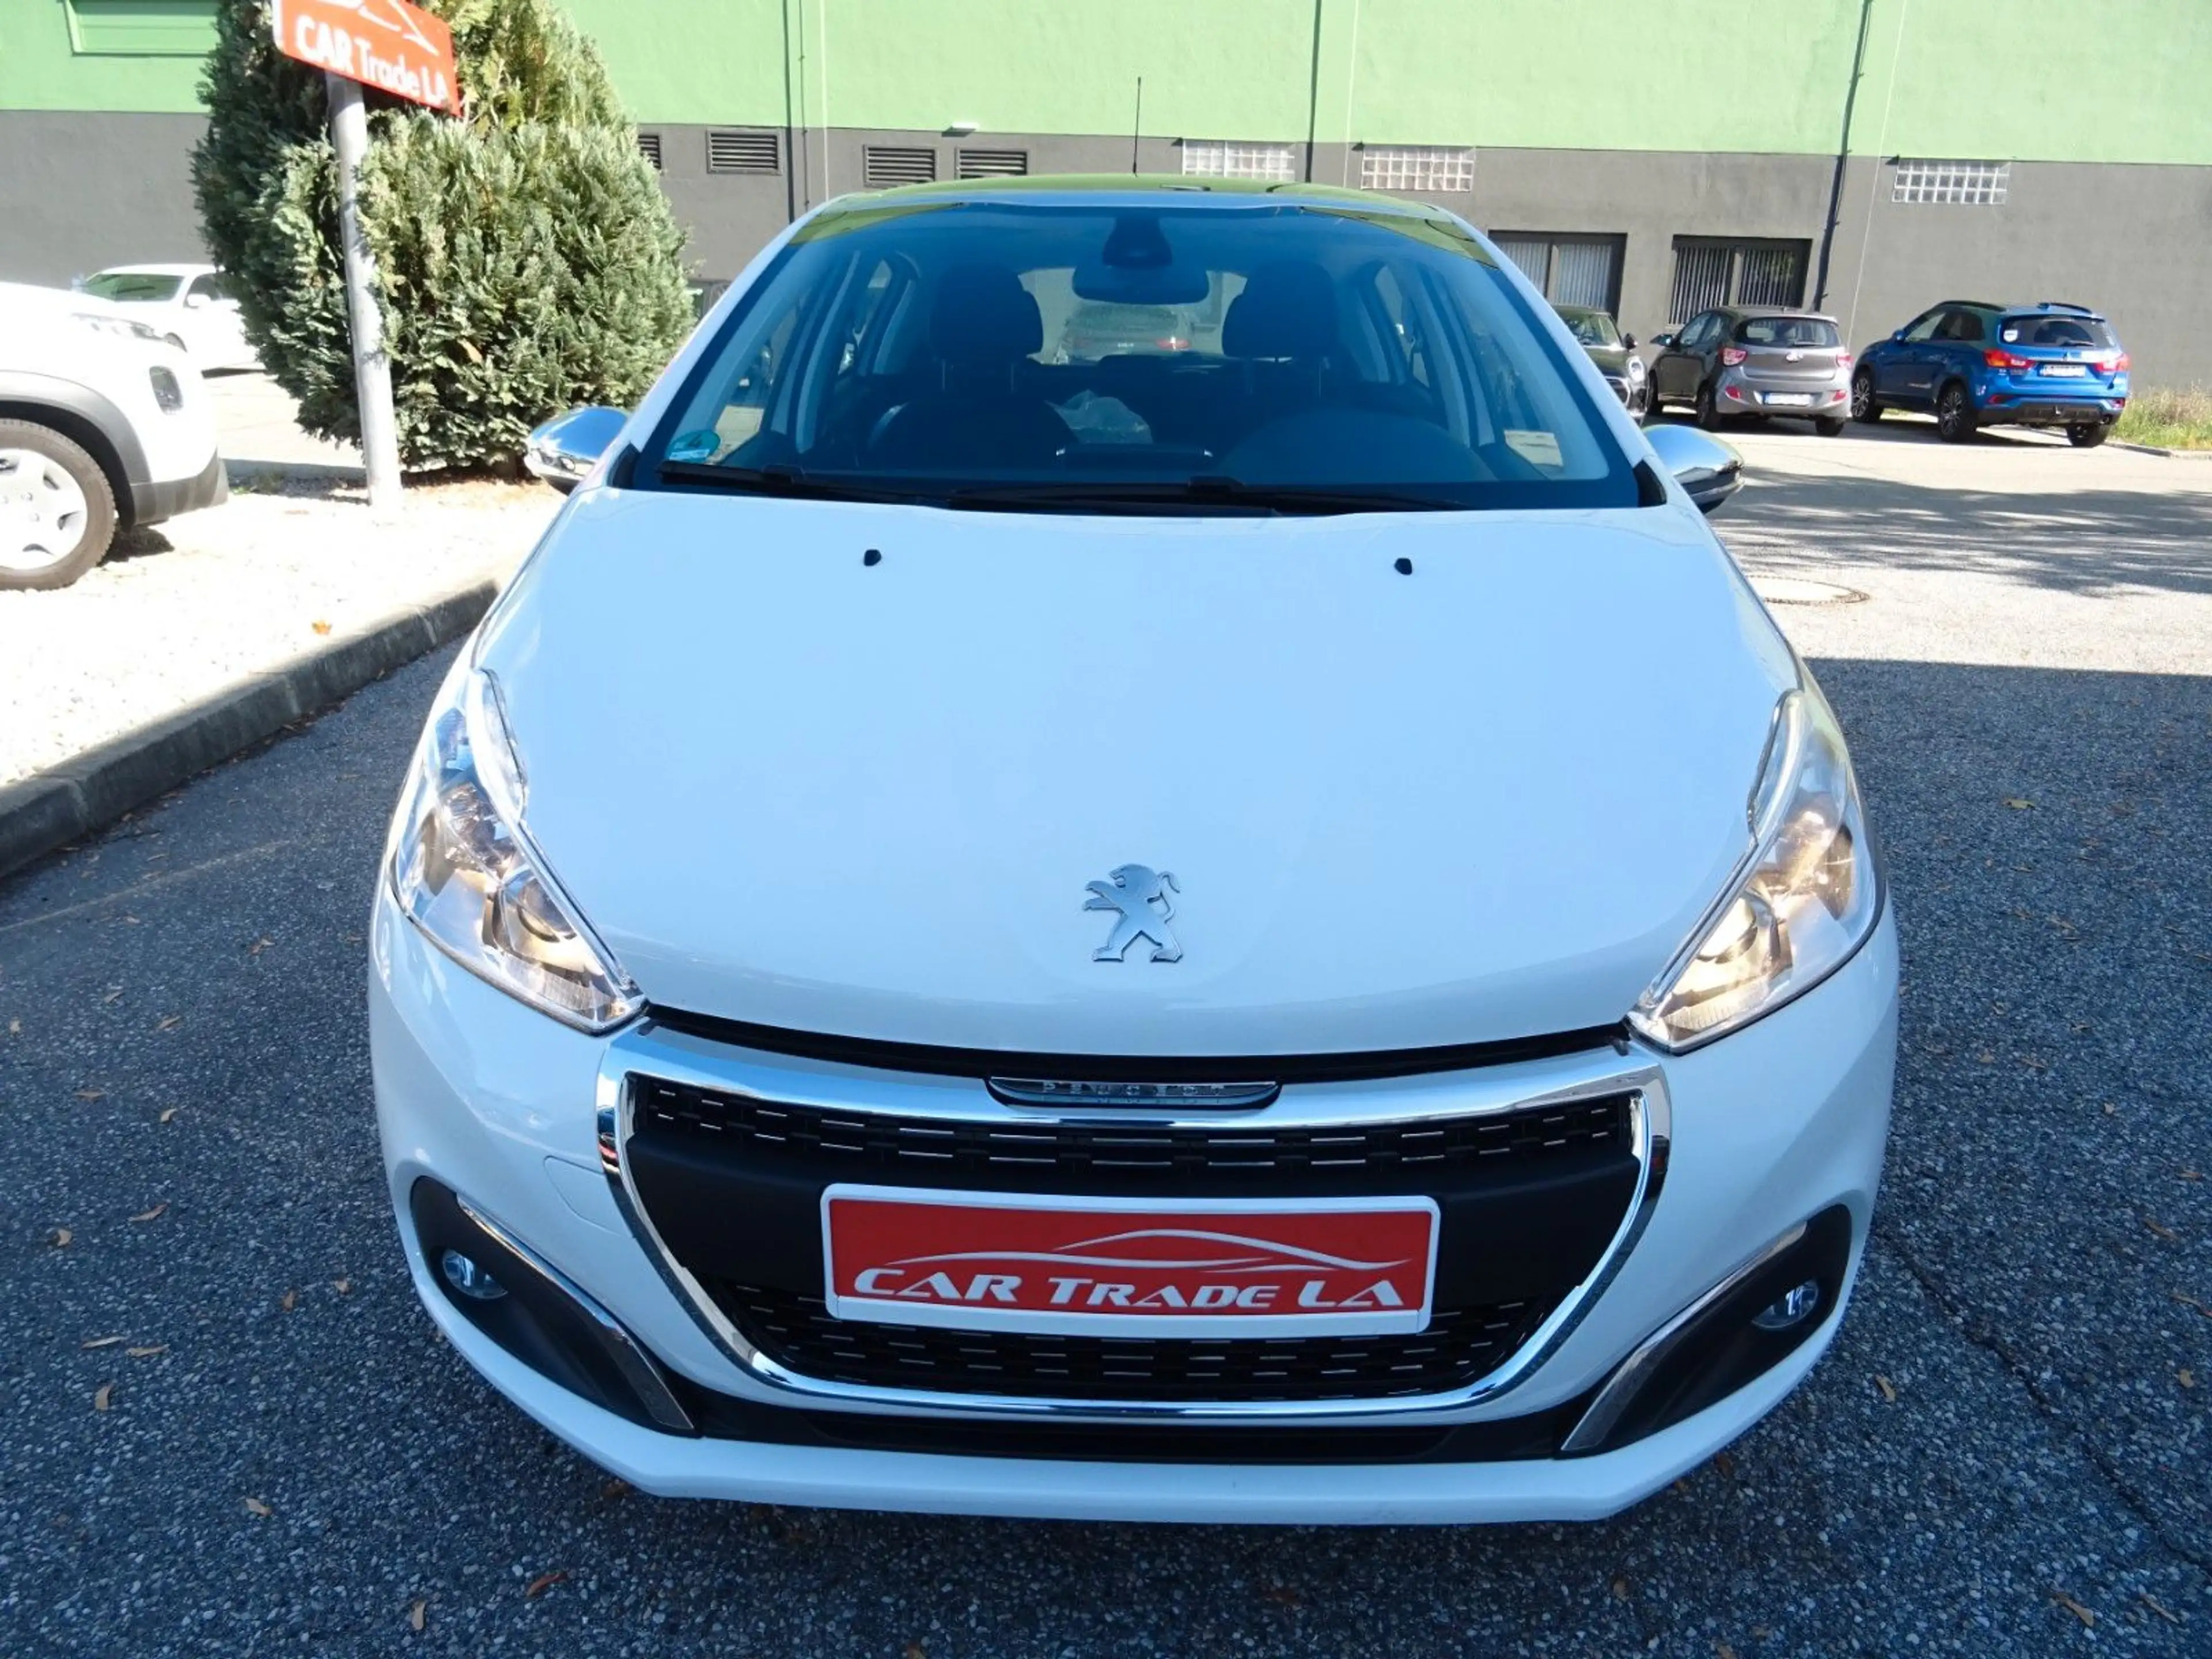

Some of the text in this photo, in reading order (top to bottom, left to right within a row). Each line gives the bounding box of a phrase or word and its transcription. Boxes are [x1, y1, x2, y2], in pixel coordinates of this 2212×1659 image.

[296, 14, 449, 105] CAR Trade LA
[854, 1268, 1404, 1308] CAR TRADE LA
